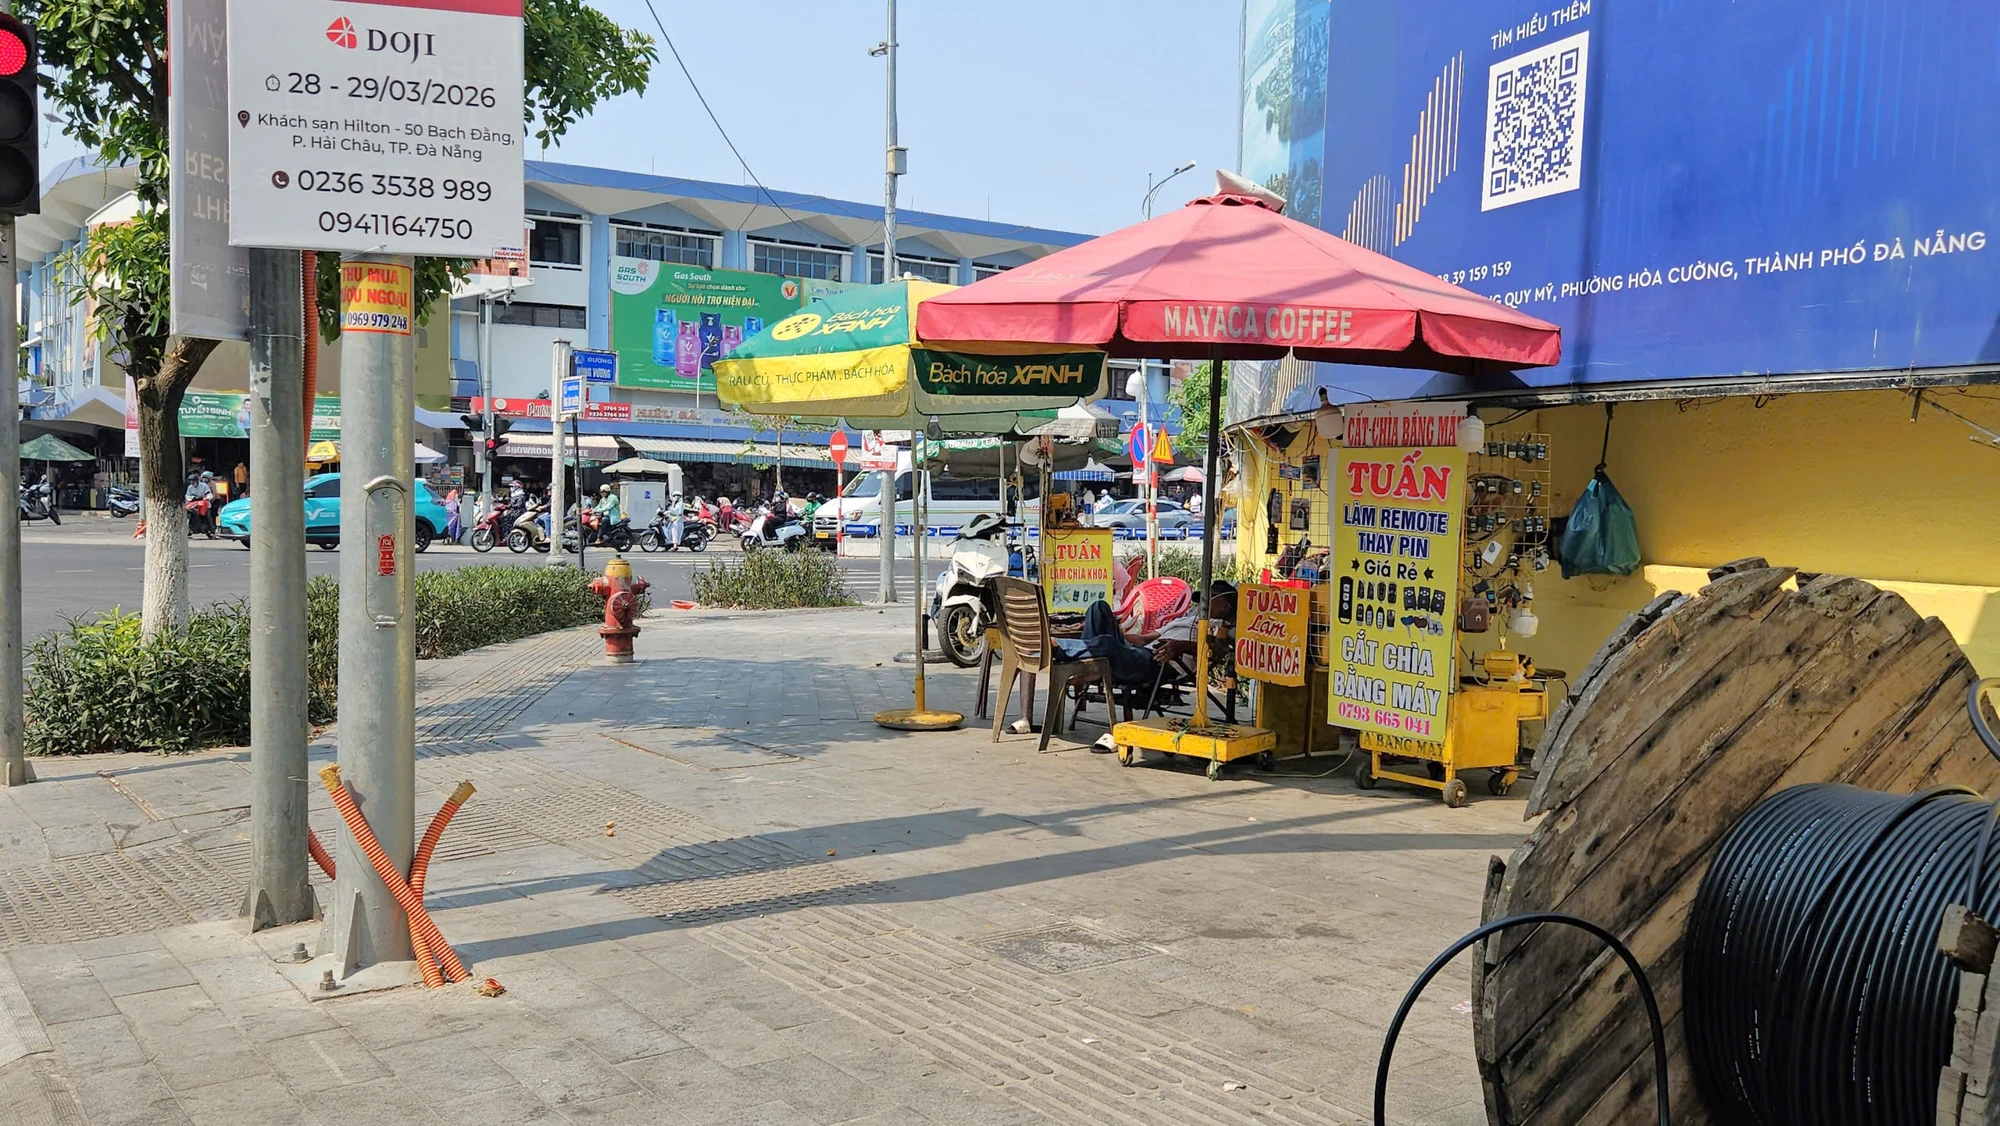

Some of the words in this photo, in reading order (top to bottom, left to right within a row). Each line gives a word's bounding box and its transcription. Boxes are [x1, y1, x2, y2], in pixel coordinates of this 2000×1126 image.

[1490, 28, 1512, 50] TÌM
[1516, 12, 1548, 40] HIỂU
[1551, 0, 1591, 26] THÊM
[366, 28, 436, 64] DOJI
[288, 73, 321, 95] 28
[347, 75, 496, 109] 29/03/2026
[258, 113, 307, 130] Khách
[312, 118, 339, 134] sạn
[344, 118, 391, 136] Hilton
[405, 123, 424, 138] 50
[428, 125, 466, 142] Bạch
[470, 128, 516, 147] Đằng,
[293, 135, 306, 149] P.
[311, 136, 337, 151] Hải
[340, 138, 385, 156] Châu,
[389, 141, 412, 156] TP.
[416, 140, 437, 157] Đà
[442, 142, 483, 163] Nẵng
[298, 170, 364, 194] 0236
[372, 174, 435, 199] 3538
[443, 180, 492, 202] 989
[318, 211, 473, 240] 0941164750
[343, 267, 362, 282] THU
[367, 268, 399, 285] MUA
[616, 274, 646, 282] SOUTH
[618, 266, 636, 274] GAS
[674, 271, 689, 281] Gas
[690, 273, 712, 282] South
[1452, 270, 1466, 286] 39
[1468, 266, 1488, 282] 159
[1492, 260, 1512, 278] 159
[1504, 288, 1531, 309] QUY
[1534, 282, 1557, 302] MỸ,
[1561, 274, 1624, 298] PHƯỜNG
[1628, 267, 1663, 290] HÒA
[1668, 260, 1738, 286] CƯỜNG,
[1744, 252, 1814, 275] THÀNH
[1820, 238, 1866, 268] PHỐ
[1873, 237, 1905, 262] ĐÀ
[1913, 229, 1986, 258] NẴNG
[367, 289, 407, 309] NGOẠI
[664, 293, 690, 304] NGƯỜI
[692, 294, 705, 306] NỘI
[707, 296, 722, 307] TRỢ
[722, 296, 742, 308] HIỆN
[348, 313, 369, 326] 0969
[372, 314, 390, 328] 979
[392, 315, 408, 330] 248
[810, 315, 896, 336] XANH
[1164, 306, 1259, 338] MAYACA
[1265, 307, 1352, 342] COFFEE
[730, 376, 751, 387] RAU
[753, 373, 769, 386] CỦ
[776, 372, 804, 386] THỰC
[844, 366, 873, 380] BÁCH
[874, 364, 895, 376] HÓA
[929, 362, 970, 384] Bách
[976, 364, 1008, 385] hóa
[1010, 364, 1084, 385] XANH
[179, 404, 209, 414] TUYỂN
[210, 408, 232, 416] SINH
[1372, 410, 1398, 446] CHÌA
[505, 446, 554, 456] SHOWROOM
[1347, 450, 1451, 501] TUẤN
[1343, 501, 1377, 527] LÀM
[1380, 507, 1450, 536] REMOTE
[1056, 538, 1101, 560] TUẤN
[1358, 532, 1394, 556] THAY
[1399, 536, 1429, 560] PIN
[1364, 559, 1391, 578] Giá
[1397, 562, 1418, 581] Rẻ
[1246, 614, 1287, 639] Làm
[1341, 629, 1379, 666] CẮT
[1383, 642, 1435, 678] CHÌA
[1332, 664, 1386, 706] BẰNG
[1392, 681, 1442, 717] MÁY
[1338, 702, 1371, 723] 0793
[1374, 709, 1402, 729] 665
[1405, 716, 1432, 736] 041
